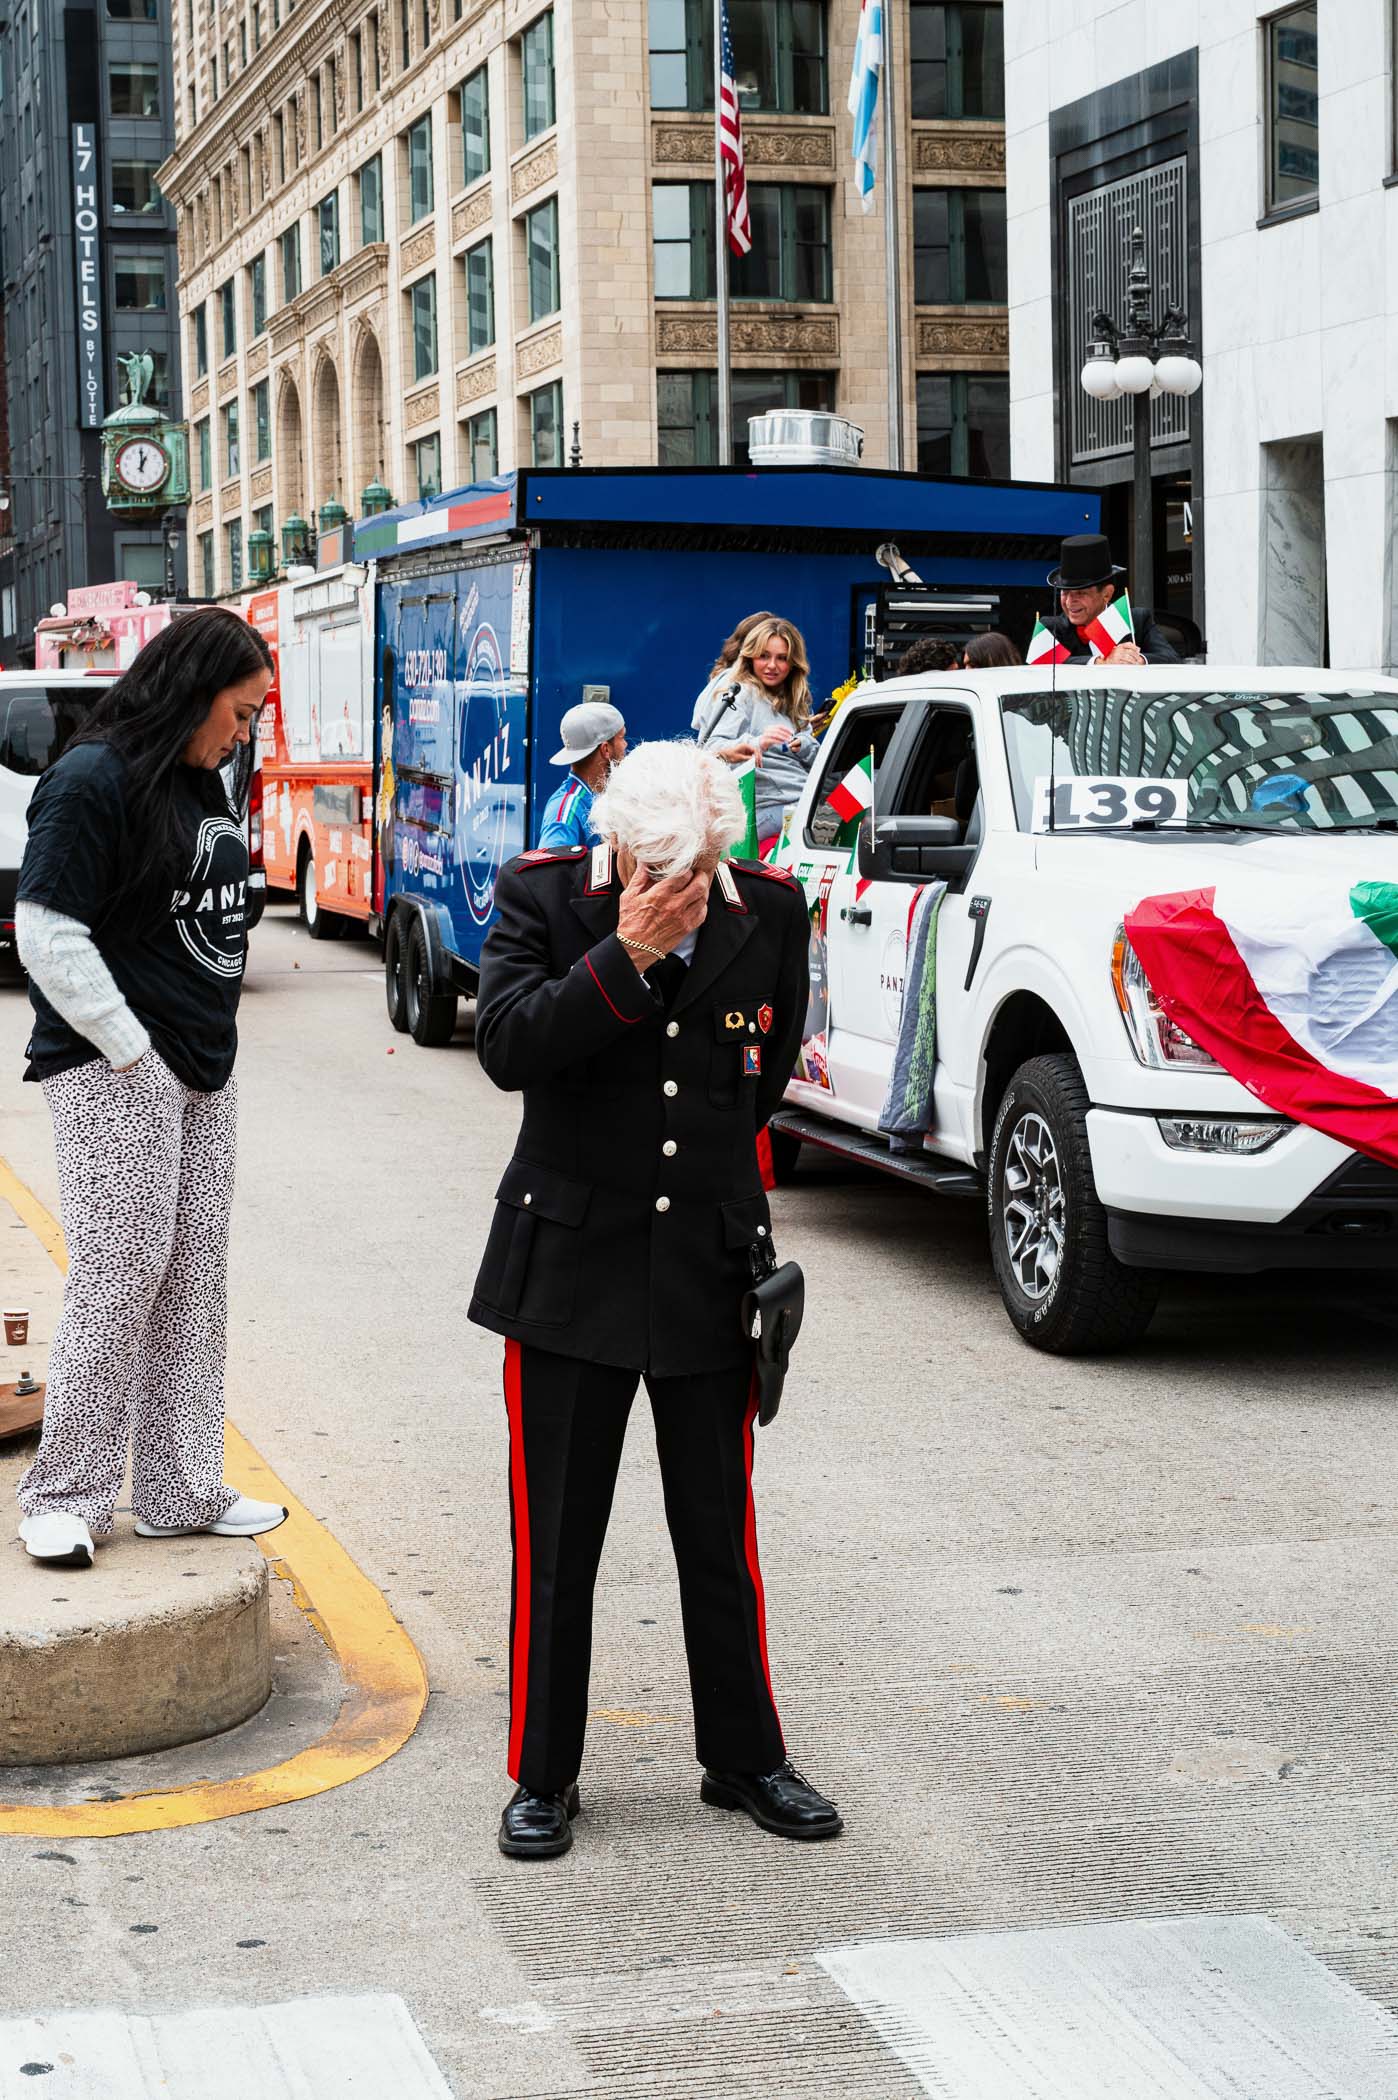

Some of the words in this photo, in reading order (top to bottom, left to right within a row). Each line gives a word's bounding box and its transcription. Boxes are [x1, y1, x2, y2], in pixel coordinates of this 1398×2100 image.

[77, 126, 92, 172] L7
[75, 185, 98, 331] HOTELS
[86, 340, 95, 362] BY
[86, 369, 98, 425] LOTTE
[456, 722, 510, 825] PANZIZ
[1043, 783, 1177, 824] 139
[218, 956, 243, 968] CHICAGO
